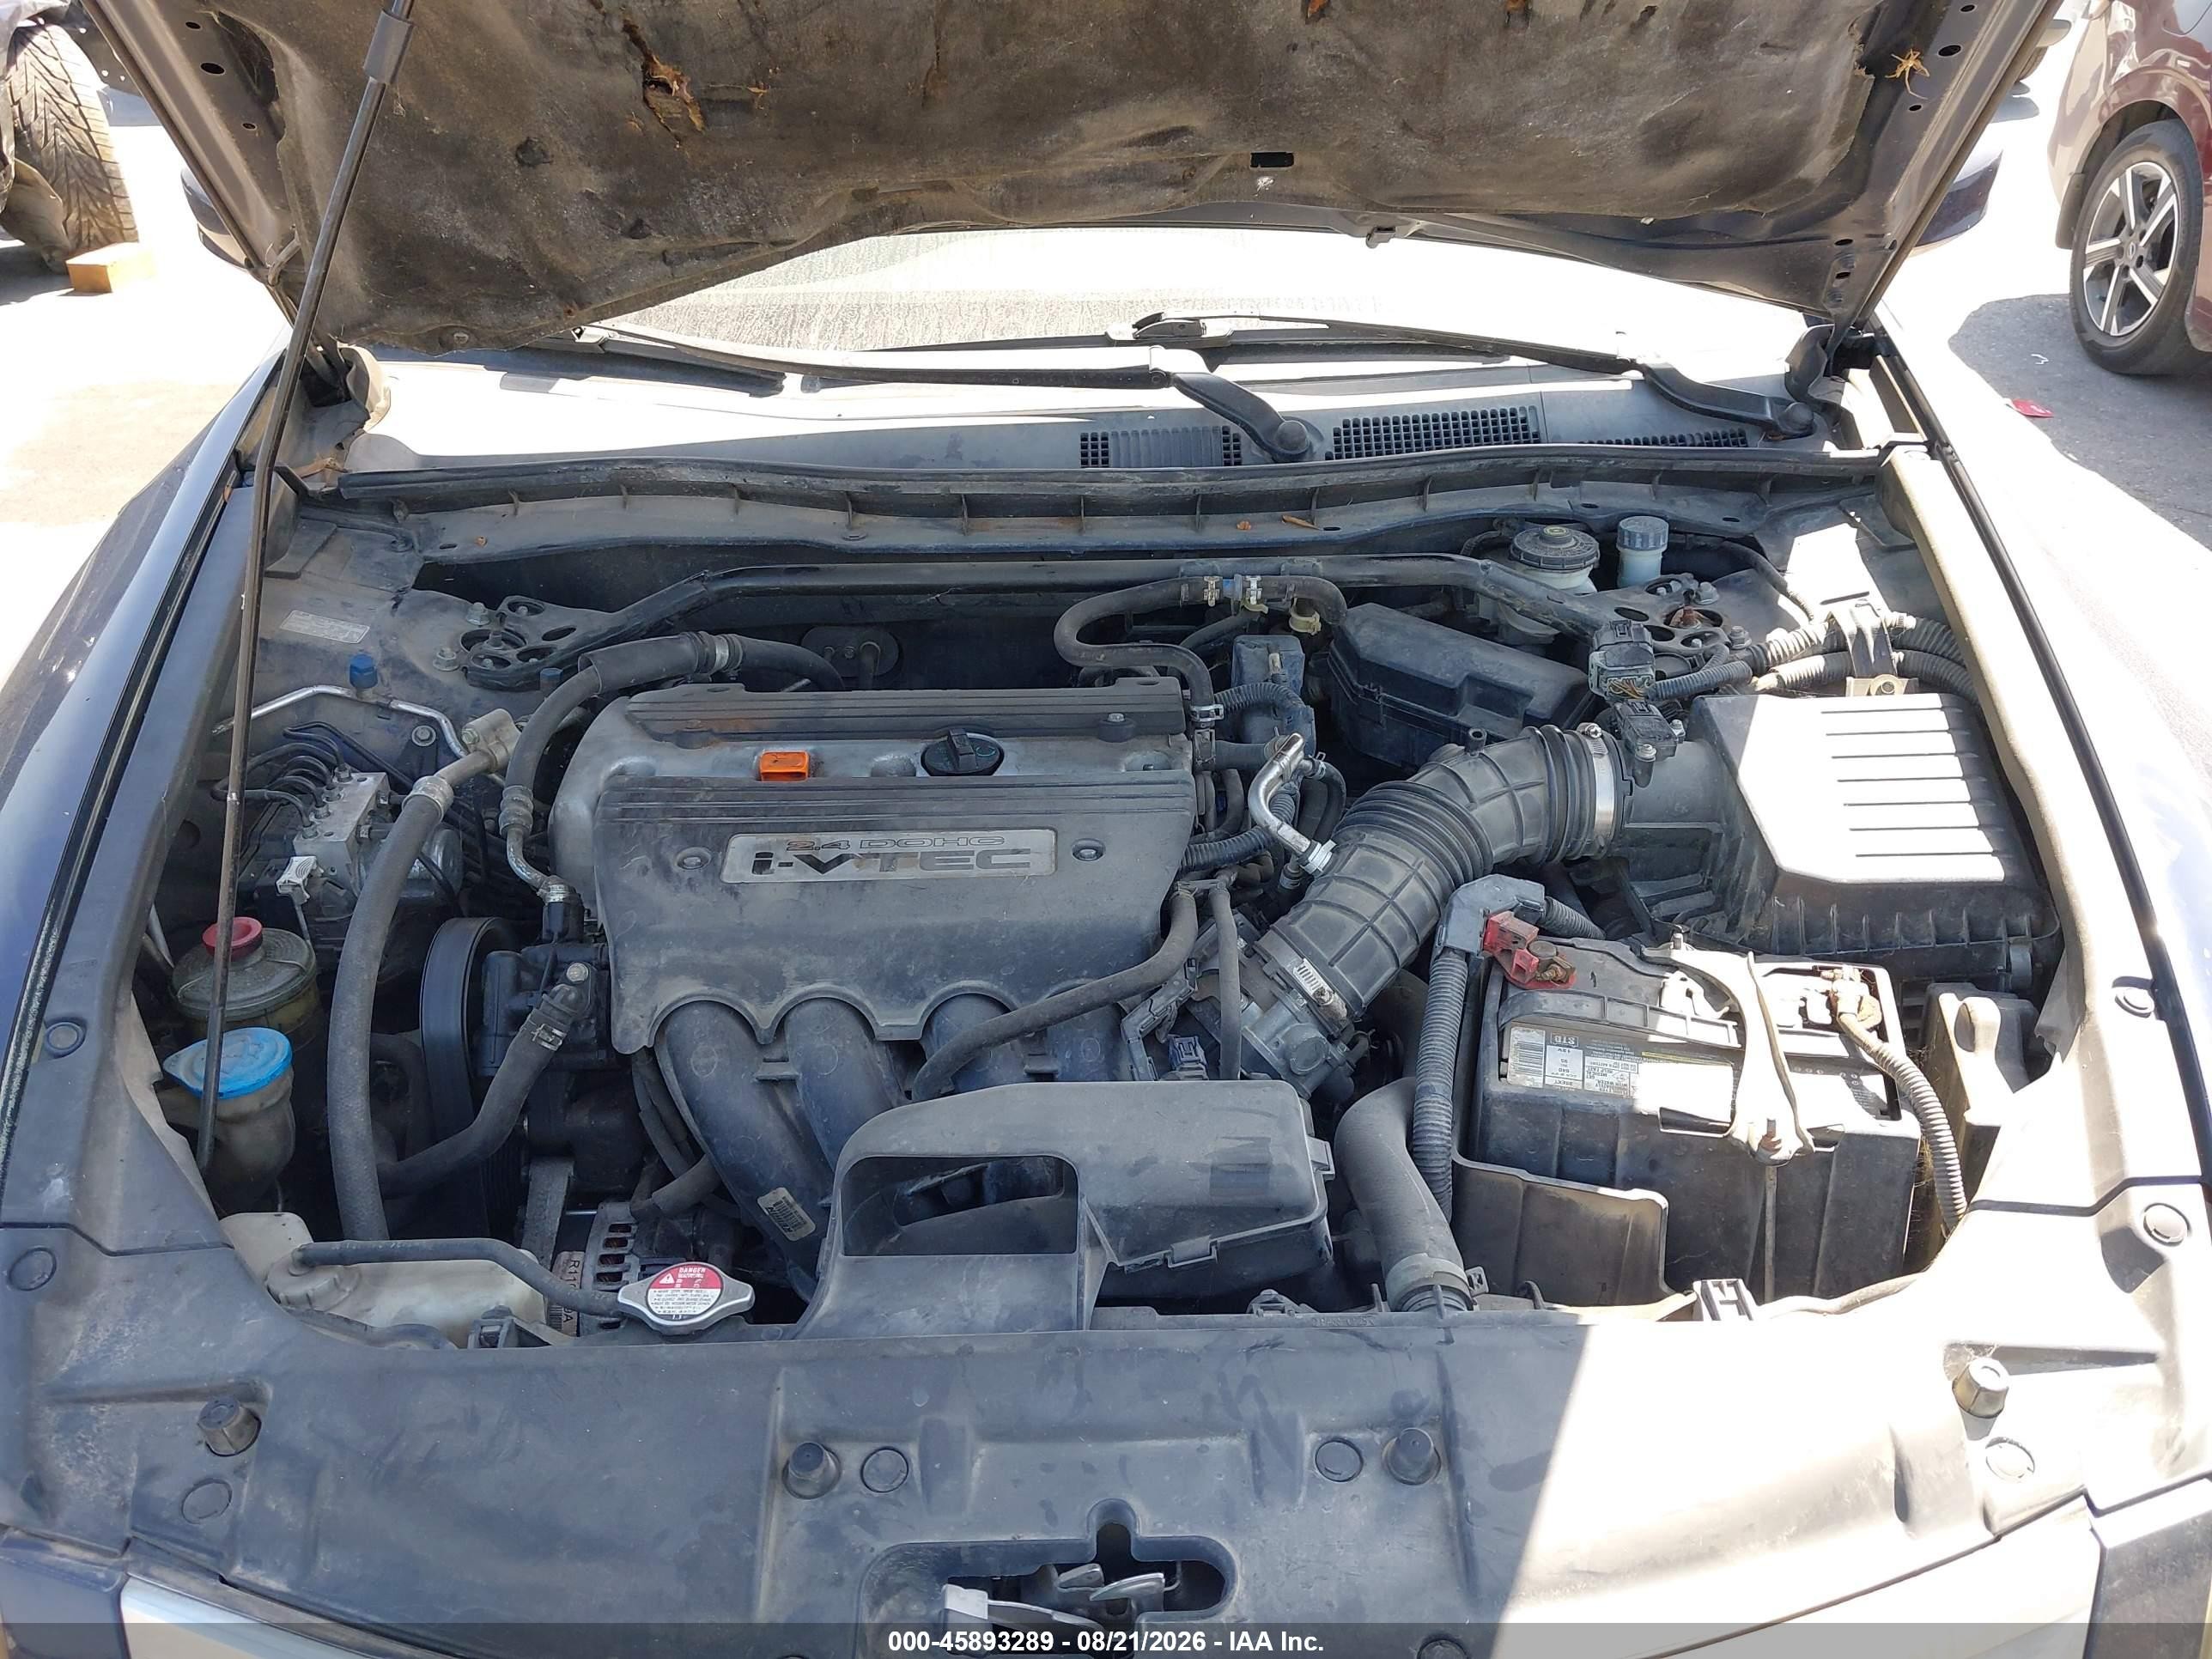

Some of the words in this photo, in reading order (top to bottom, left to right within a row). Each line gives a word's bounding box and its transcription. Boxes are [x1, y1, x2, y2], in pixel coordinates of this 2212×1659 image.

[787, 839, 850, 851] 2.4
[860, 836, 1005, 849] DOHC
[751, 848, 1031, 875] i-VTEC
